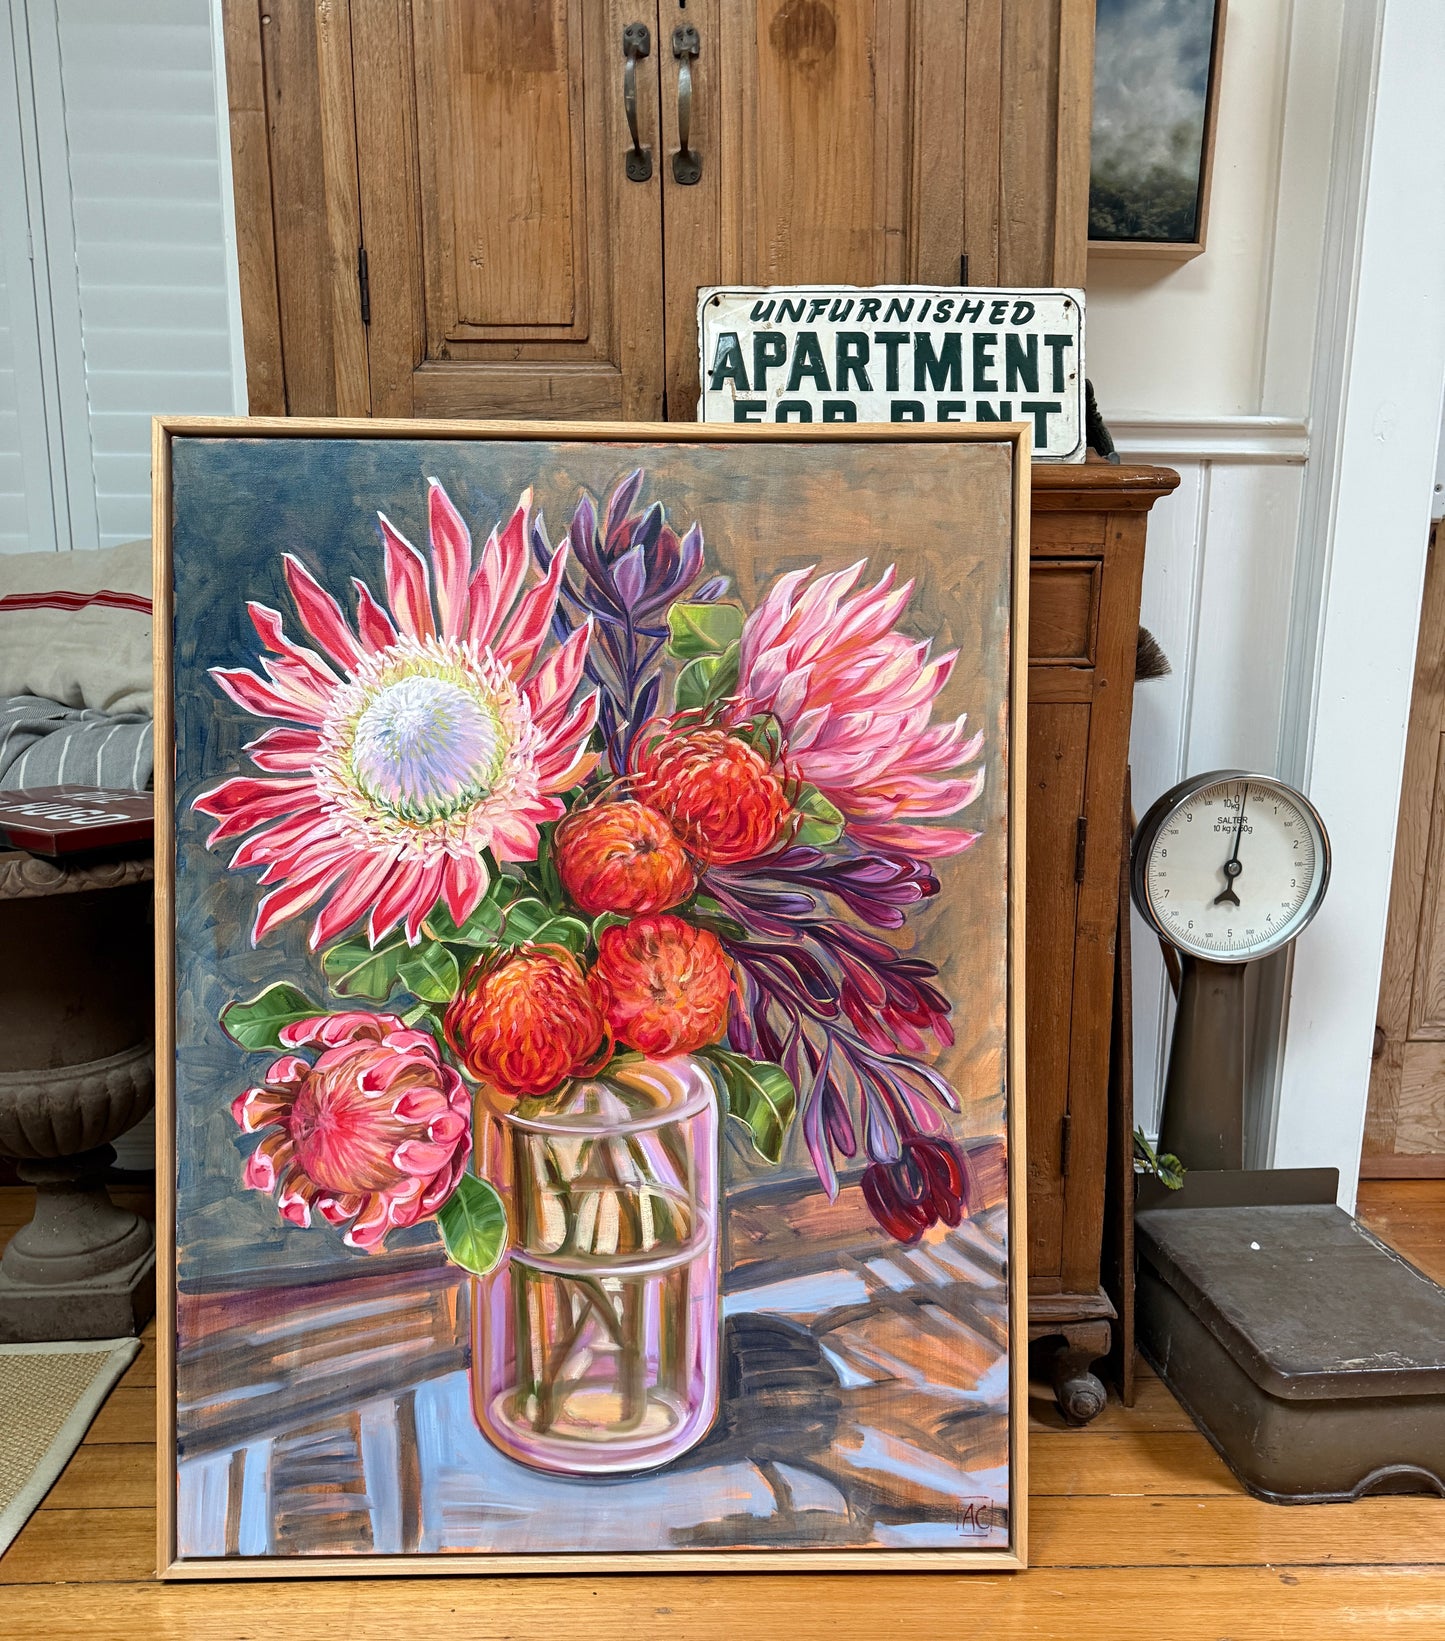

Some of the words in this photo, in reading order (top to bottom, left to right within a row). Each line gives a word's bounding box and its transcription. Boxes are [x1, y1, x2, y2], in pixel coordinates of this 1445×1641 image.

[749, 297, 1036, 325] UNFURNISHED
[709, 331, 1074, 393] APARTMENT
[1186, 813, 1193, 823] 9
[1217, 816, 1248, 824] SALTER
[1213, 824, 1221, 832] 10
[1222, 824, 1231, 834] kg
[1293, 839, 1299, 849] 2
[1161, 848, 1168, 858] 8
[1290, 878, 1296, 888] 3
[1164, 889, 1170, 898] 7
[1265, 913, 1271, 922] 4
[1188, 920, 1194, 929] 6
[1227, 928, 1233, 938] 5
